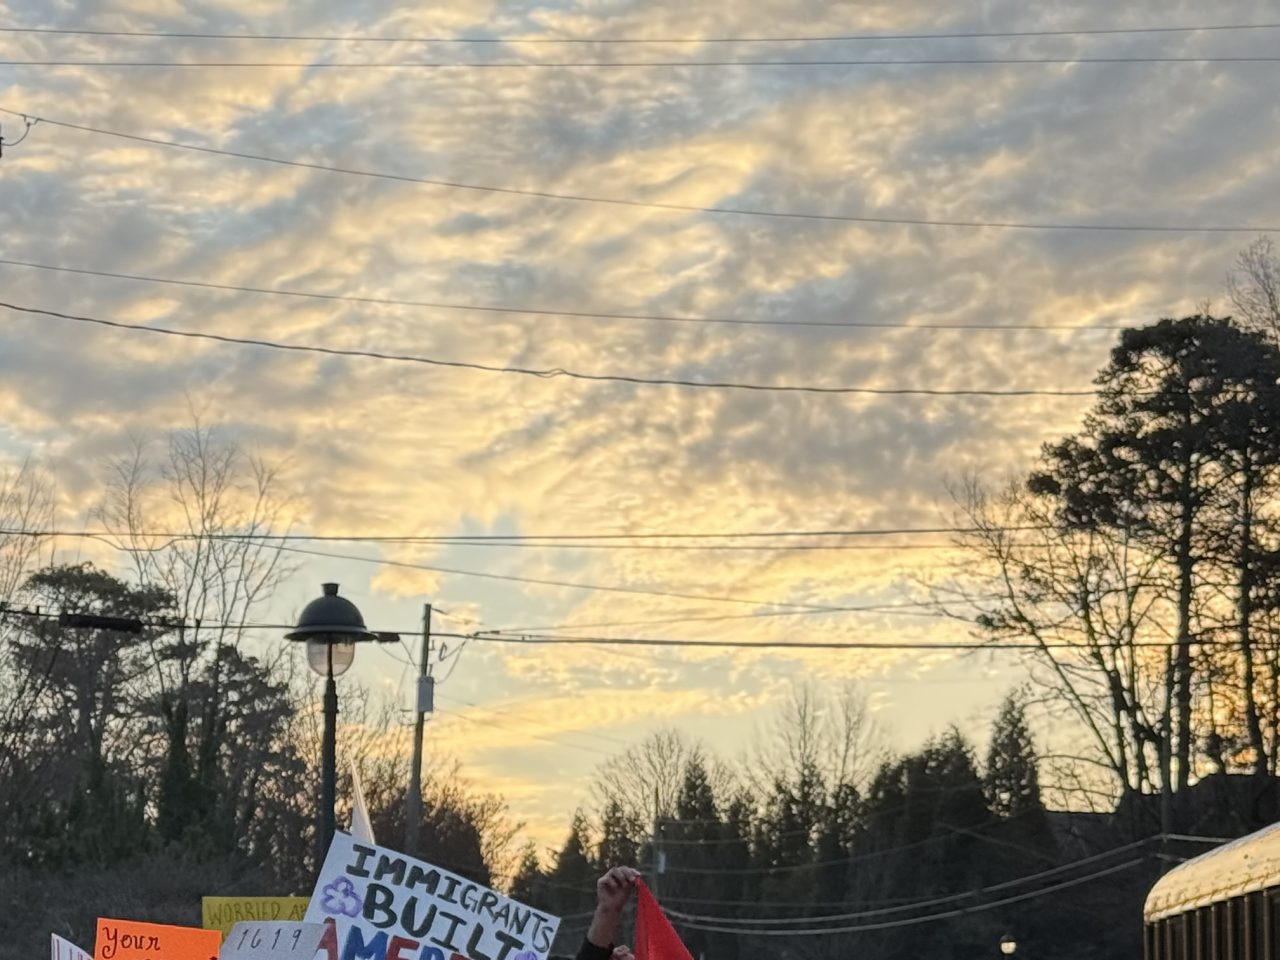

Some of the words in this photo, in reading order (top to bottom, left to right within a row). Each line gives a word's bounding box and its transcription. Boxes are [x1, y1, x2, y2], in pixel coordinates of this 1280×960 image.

[345, 843, 554, 954] IMMIGRANTS
[206, 901, 281, 925] WORRIED
[236, 928, 303, 951] 1619
